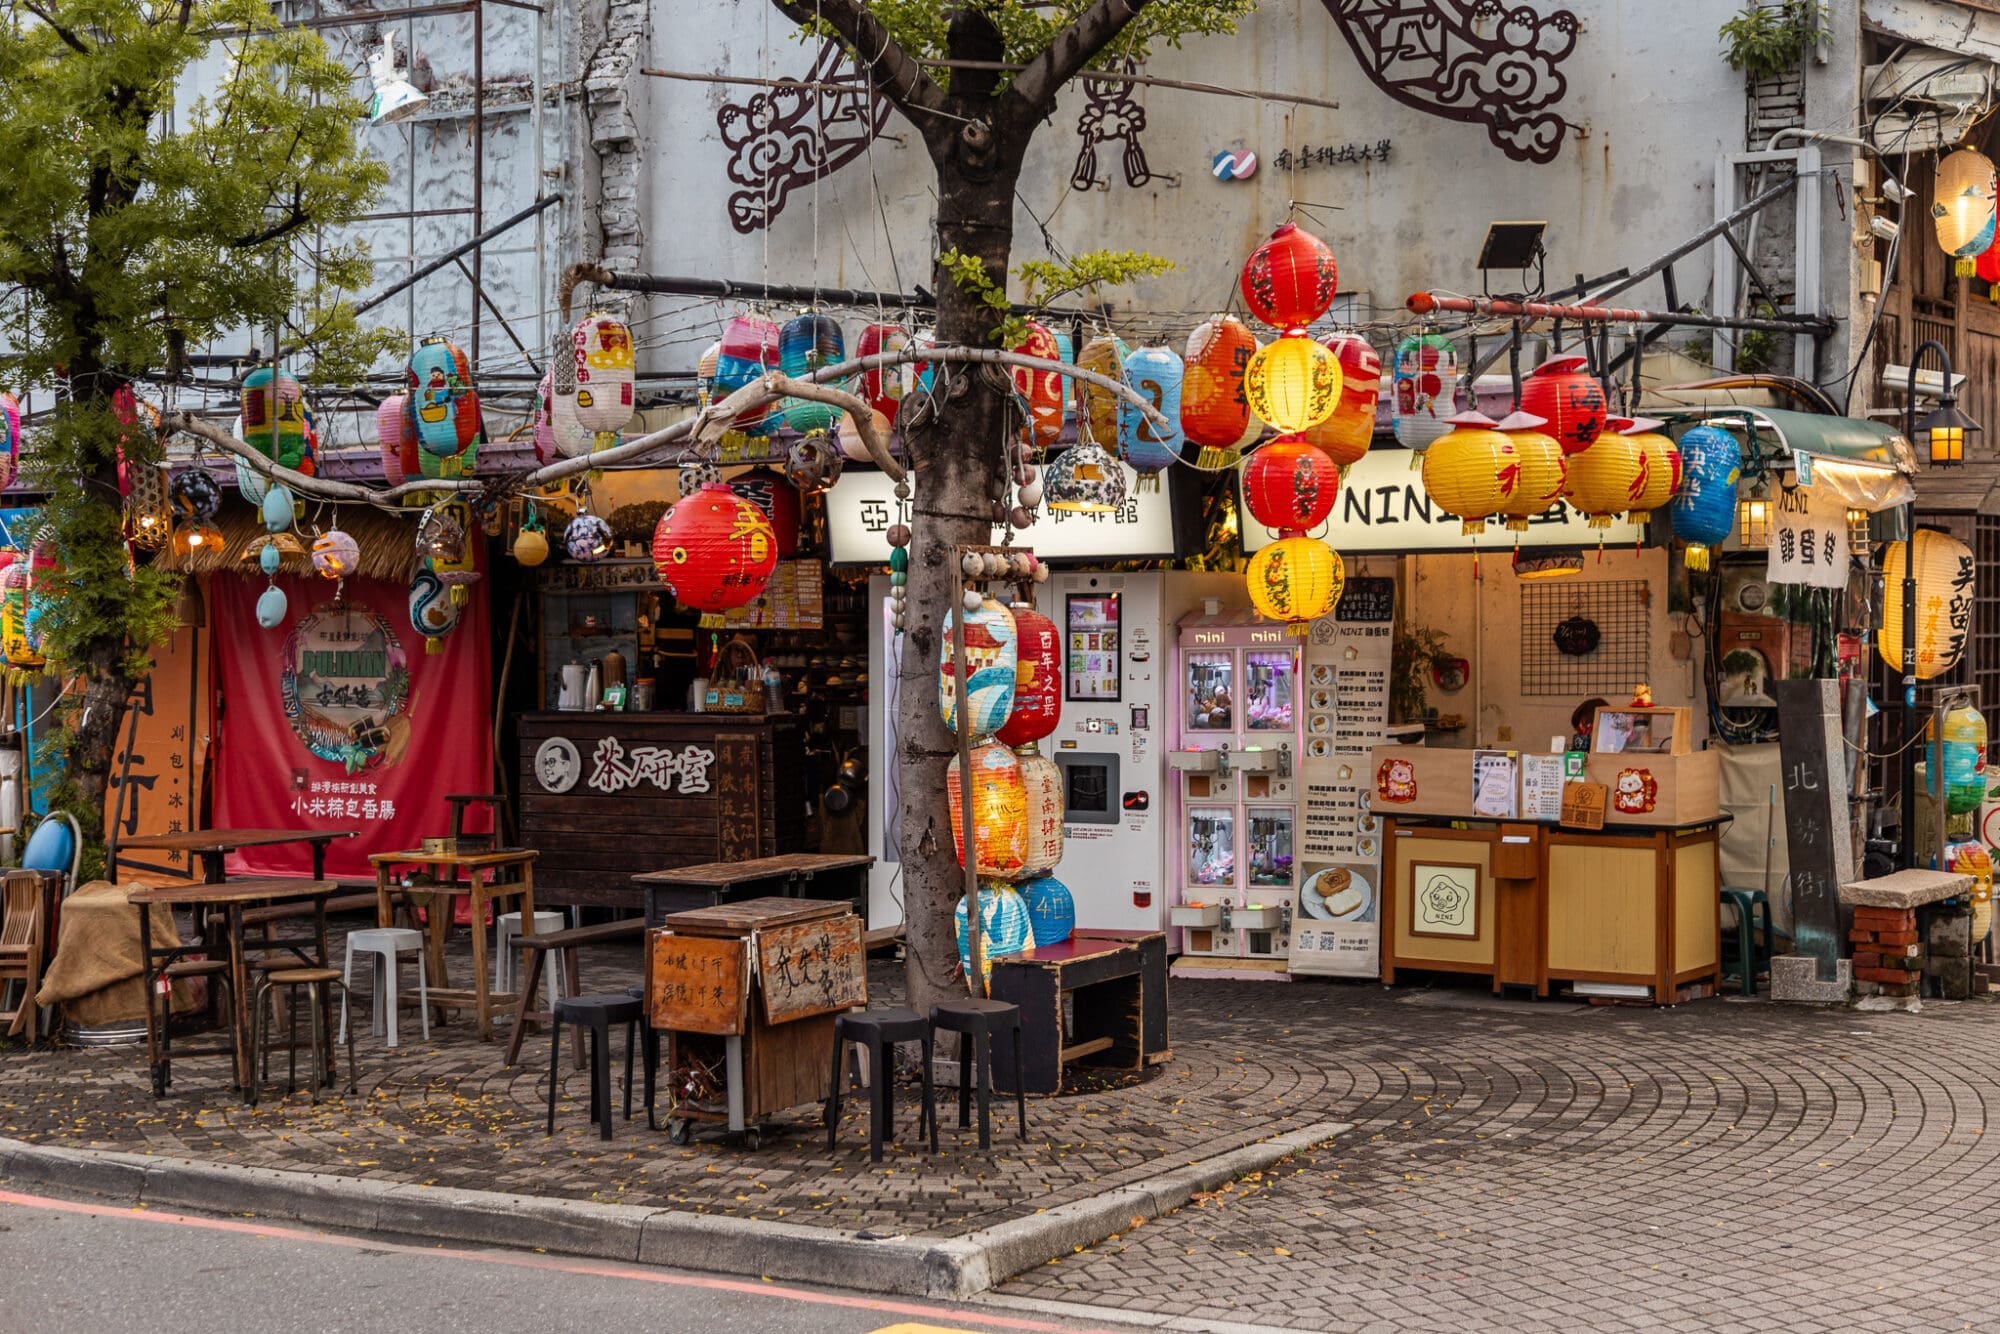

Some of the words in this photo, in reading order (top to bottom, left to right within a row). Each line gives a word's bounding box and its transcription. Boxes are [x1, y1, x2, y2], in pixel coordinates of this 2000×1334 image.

[1344, 484, 1460, 526] NIN
[1194, 631, 1225, 643] mini
[1250, 630, 1281, 642] mini
[1340, 627, 1364, 637] NINI
[302, 650, 386, 678] PULIMAN
[592, 739, 712, 791] 茶研室
[290, 796, 396, 820] 小米粽包香腸
[1435, 913, 1453, 921] NINI
